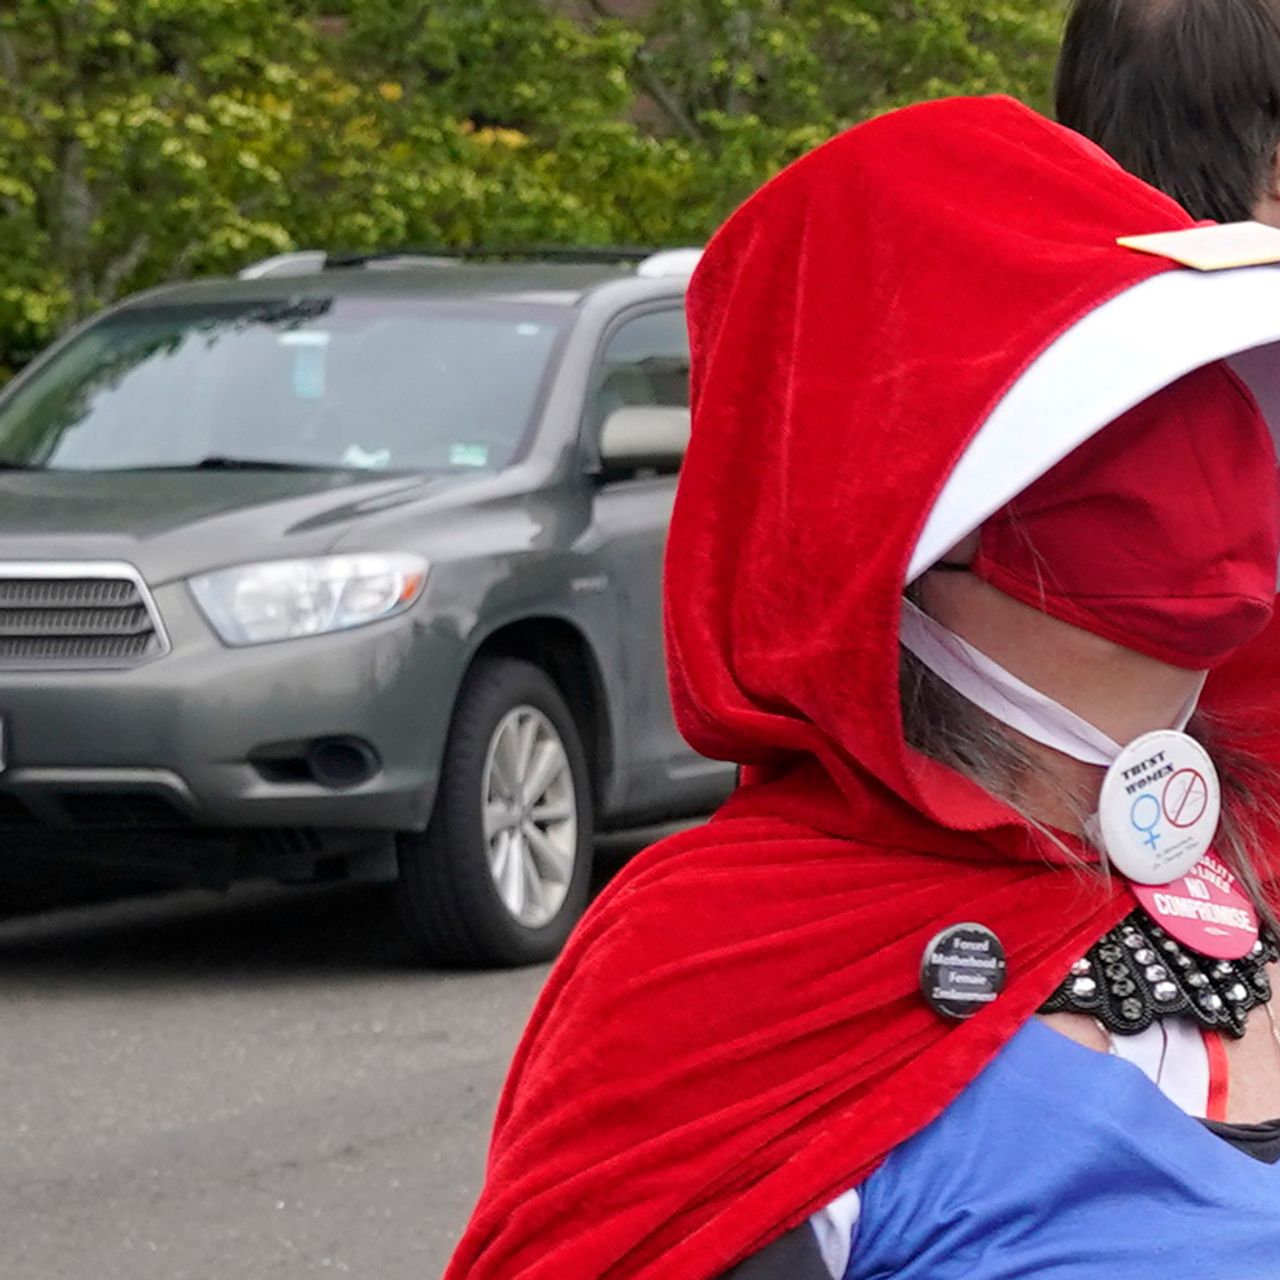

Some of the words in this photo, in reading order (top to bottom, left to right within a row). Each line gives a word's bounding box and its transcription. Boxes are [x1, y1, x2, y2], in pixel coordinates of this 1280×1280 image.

[1122, 750, 1165, 780] TRUST
[1125, 763, 1175, 795] WOMEN
[1183, 876, 1211, 900] NO
